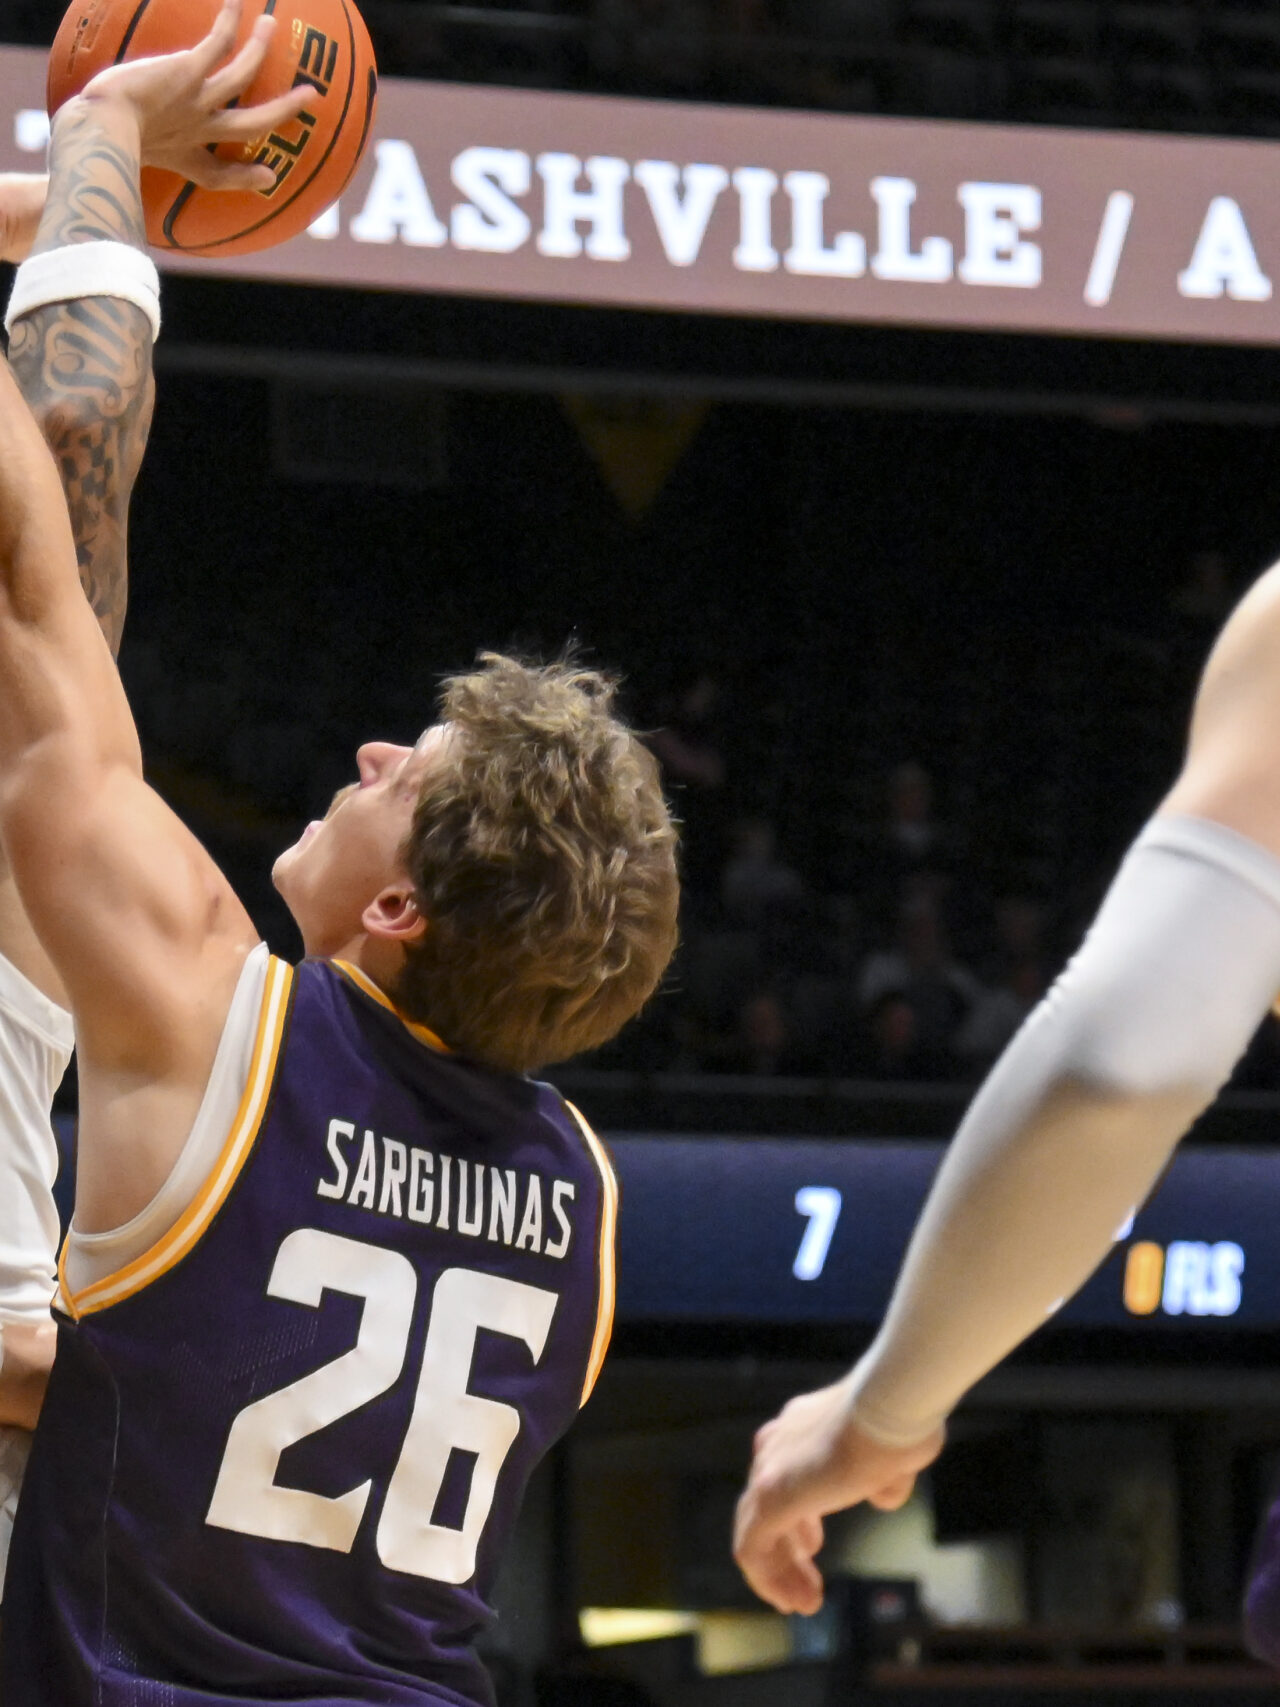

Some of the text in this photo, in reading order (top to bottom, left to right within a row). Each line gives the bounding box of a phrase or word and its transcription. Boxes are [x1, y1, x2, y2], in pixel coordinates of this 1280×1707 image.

[306, 138, 1043, 288] ASHVILLE
[1177, 197, 1273, 301] A
[317, 1119, 576, 1259] SARGIUNAS
[792, 1186, 842, 1281] 7
[205, 1228, 559, 1584] 26
